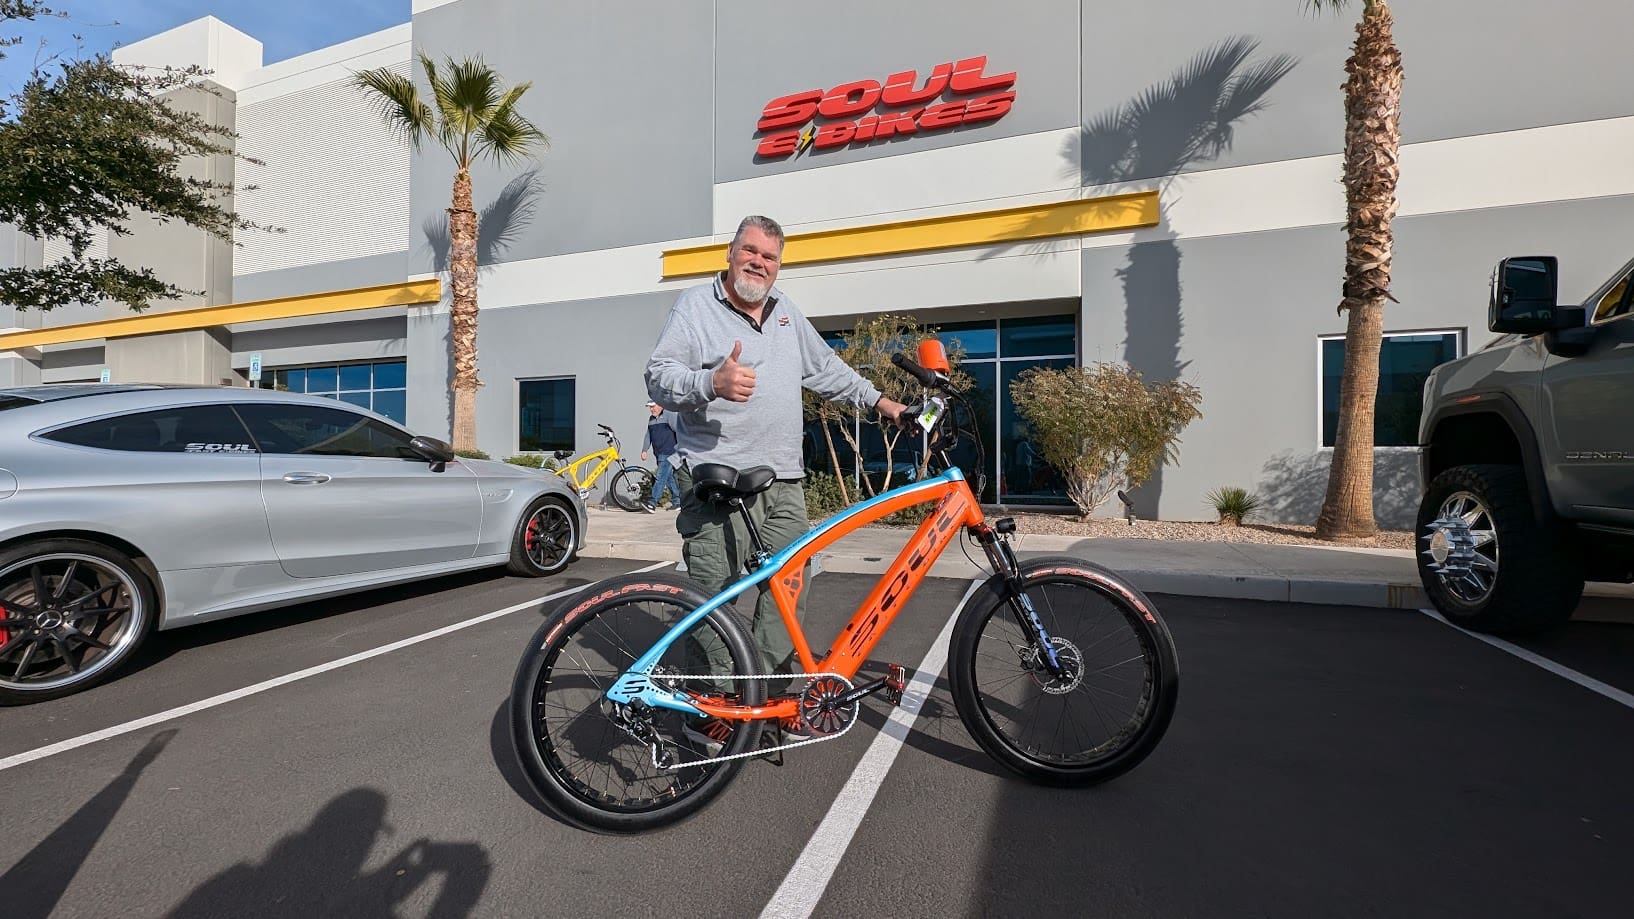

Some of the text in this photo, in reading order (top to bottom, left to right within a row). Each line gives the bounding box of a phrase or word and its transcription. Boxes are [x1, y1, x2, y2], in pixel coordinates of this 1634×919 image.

[757, 55, 1016, 132] SOUL
[184, 442, 257, 451] SOUL
[850, 499, 966, 657] SOUL
